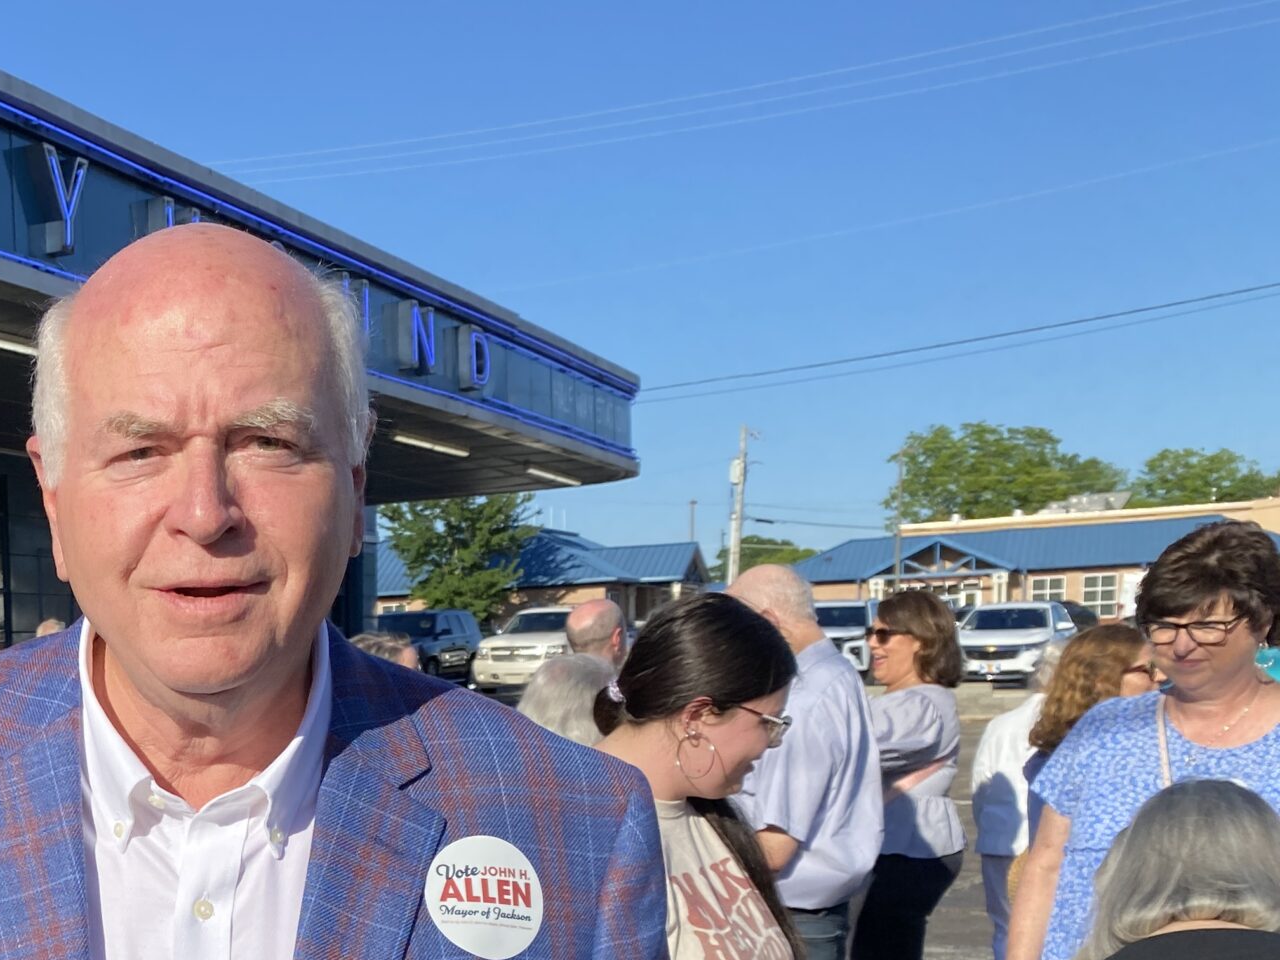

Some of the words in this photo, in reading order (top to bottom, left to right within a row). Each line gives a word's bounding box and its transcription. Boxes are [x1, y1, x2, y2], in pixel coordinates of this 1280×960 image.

[436, 864, 480, 880] Vote
[481, 866, 516, 880] JOHN
[519, 868, 531, 880] H.
[439, 877, 533, 909] ALLEN
[439, 904, 480, 918] Mayor
[481, 907, 491, 920] of
[493, 907, 533, 922] Jackson
